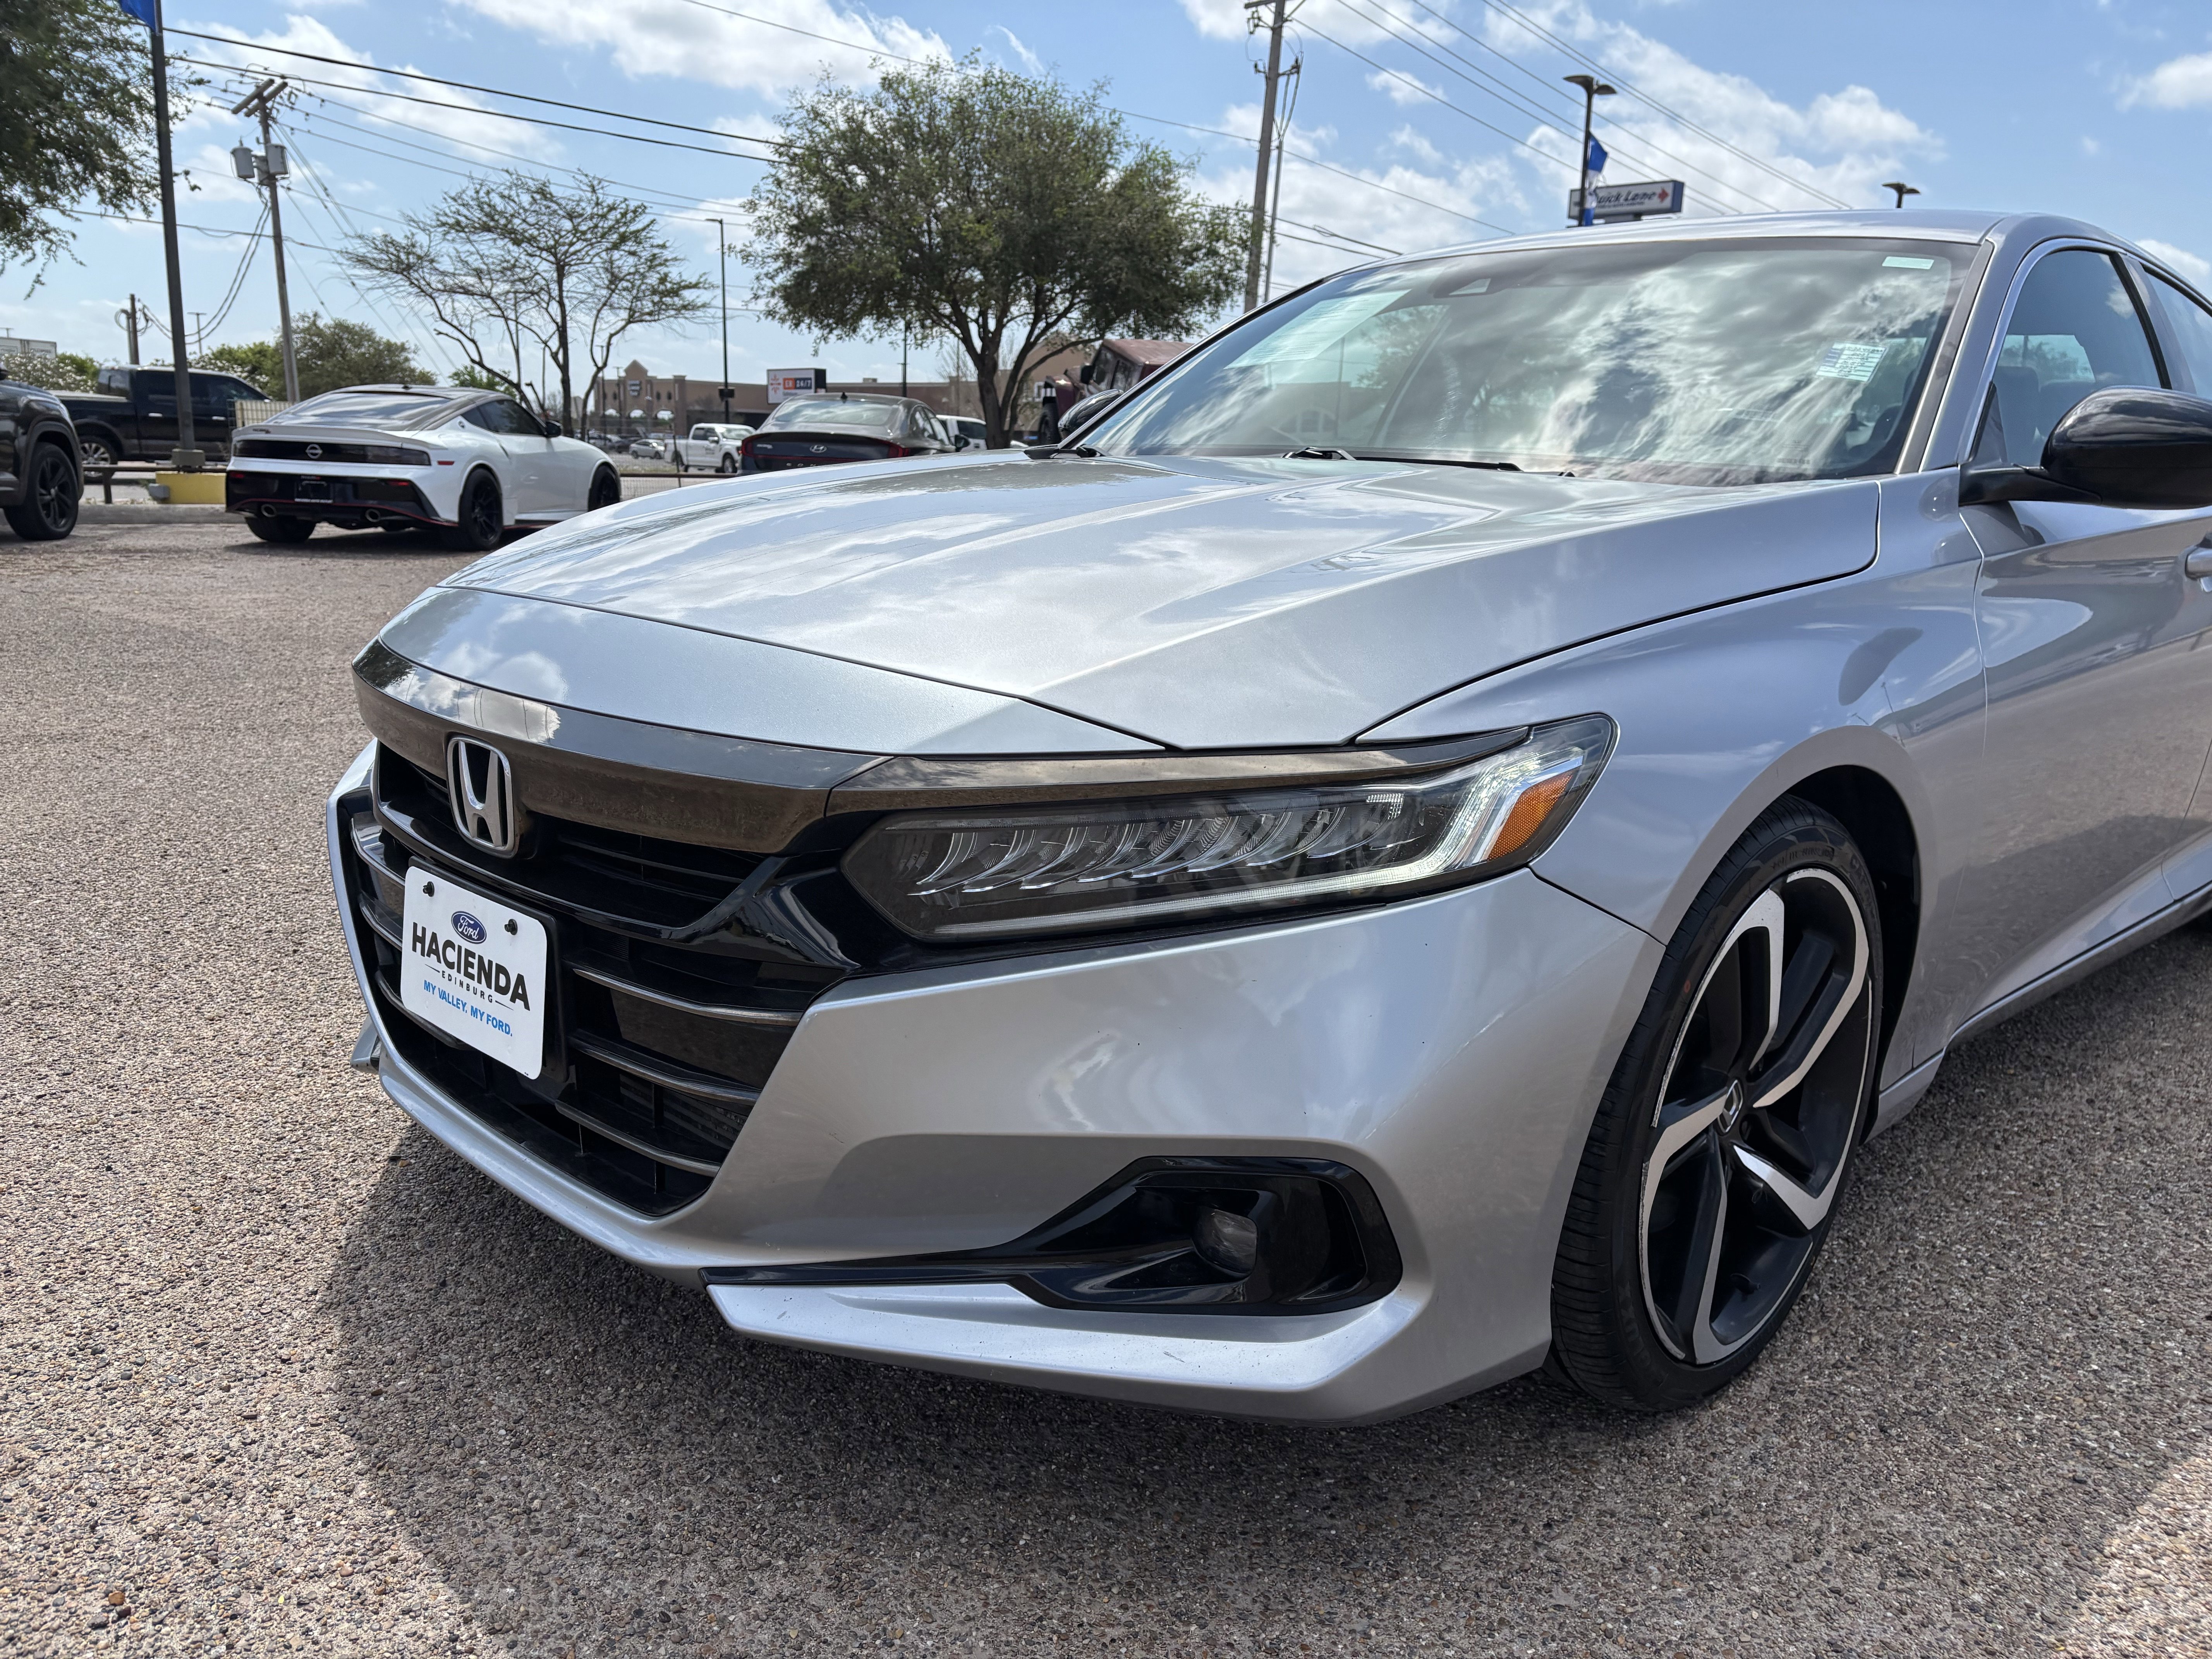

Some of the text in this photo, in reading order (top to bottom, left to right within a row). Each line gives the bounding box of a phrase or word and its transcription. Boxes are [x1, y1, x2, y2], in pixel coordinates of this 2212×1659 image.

[457, 915, 479, 939] Ford
[412, 922, 531, 1012] HACIENDA
[442, 970, 493, 1003] EDINBURG
[424, 979, 513, 1037] MY VALLEY. MY FORD.
